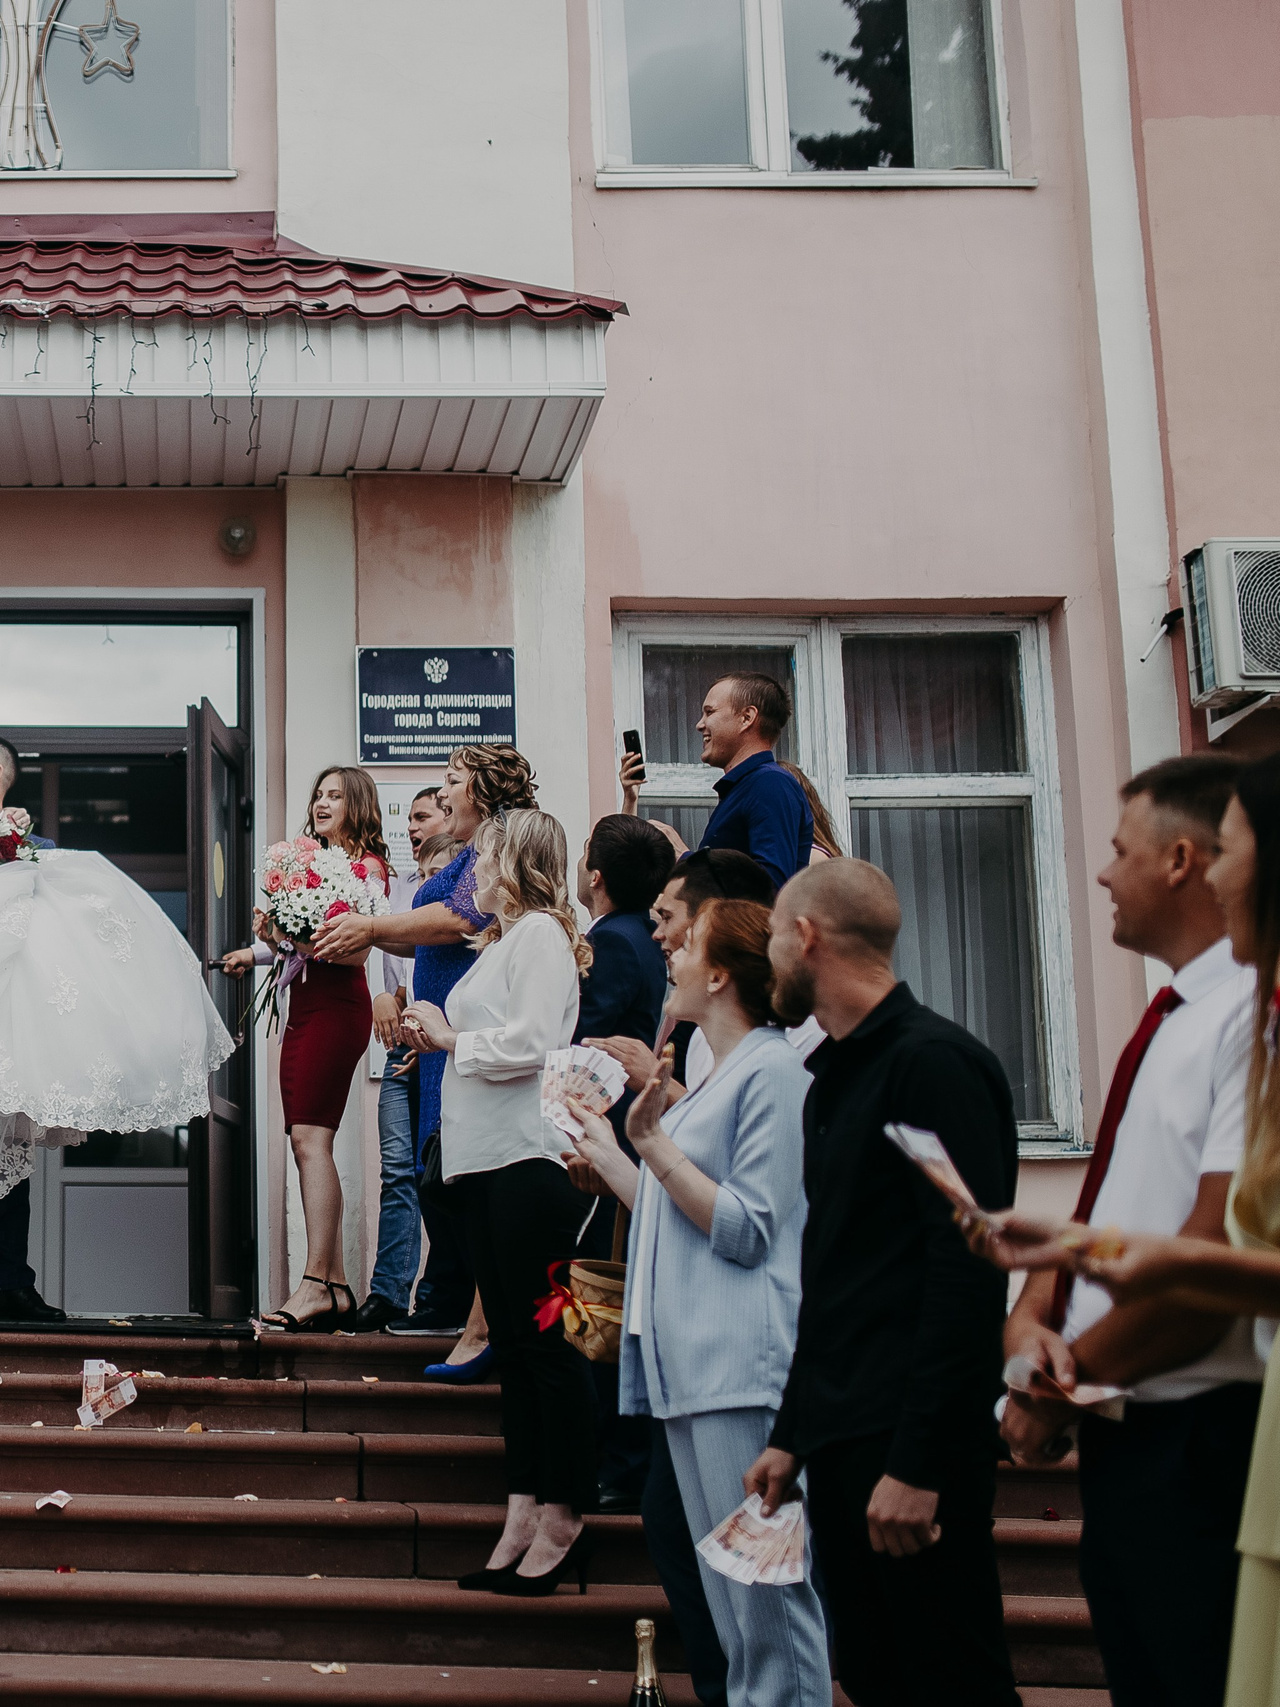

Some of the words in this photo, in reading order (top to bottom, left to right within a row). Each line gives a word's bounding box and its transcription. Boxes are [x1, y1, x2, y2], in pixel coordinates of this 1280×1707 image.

[362, 693, 420, 710] Городская
[424, 694, 512, 709] администрация
[394, 713, 433, 728] города
[437, 710, 481, 728] Сергача
[364, 734, 414, 744] Сергачского
[414, 734, 482, 744] муниципального
[483, 734, 513, 744] района
[389, 745, 453, 755] Нижегородской
